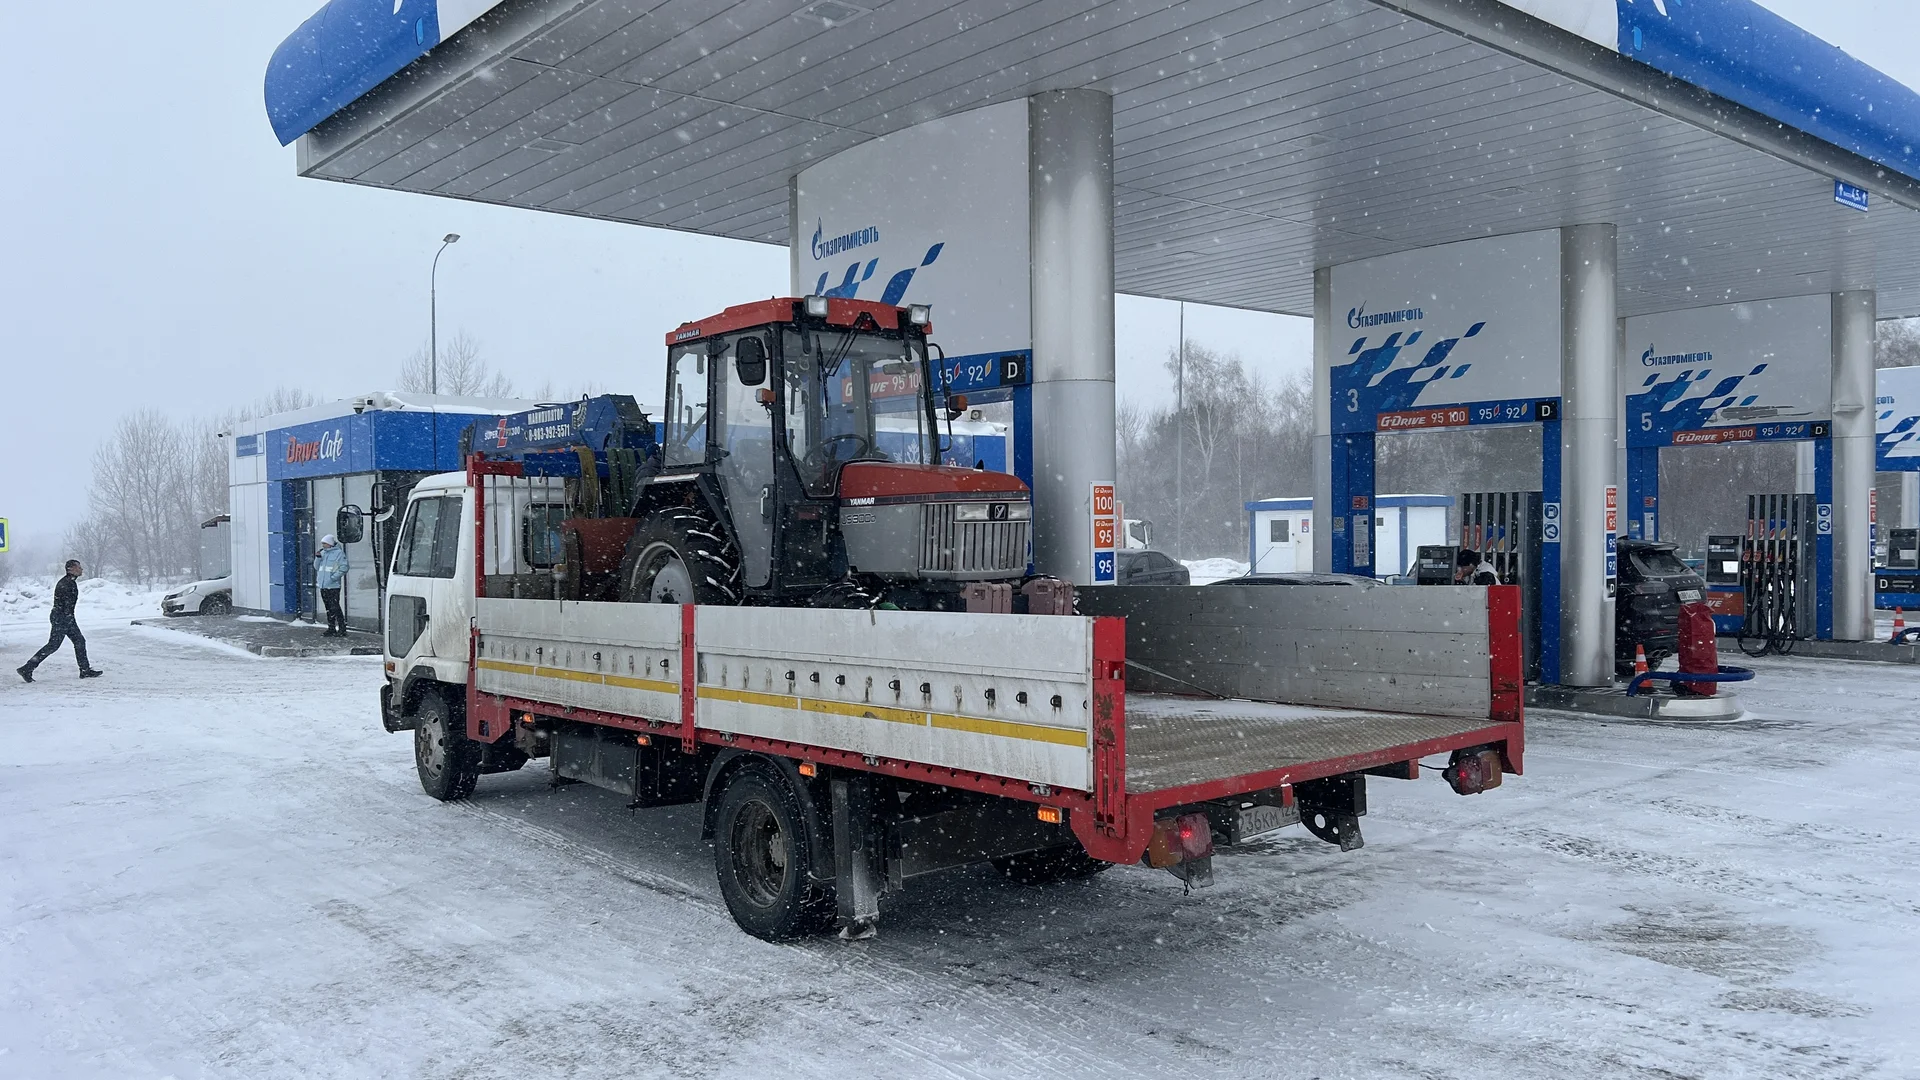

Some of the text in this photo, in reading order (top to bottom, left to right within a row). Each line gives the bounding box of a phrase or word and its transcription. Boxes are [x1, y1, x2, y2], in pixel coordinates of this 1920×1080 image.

[822, 225, 879, 258] ГАЗПРОМНЕФТЬ
[1361, 308, 1424, 327] ГАЗПРОМНЕФТЬ
[675, 329, 700, 341] YANMAR
[1655, 351, 1713, 366] ГАЗПРОМНЕФТЬ
[968, 365, 984, 383] 92
[1007, 362, 1018, 379] D
[1347, 388, 1359, 412] 3
[1431, 412, 1444, 424] 95
[1448, 410, 1466, 422] 100
[1479, 408, 1493, 420] 95
[1506, 407, 1520, 419] 92
[1541, 405, 1551, 417] D
[1641, 412, 1653, 431] 5
[1722, 430, 1735, 440] 95
[1738, 429, 1754, 438] 100
[1762, 427, 1774, 436] 95
[1785, 426, 1798, 436] 92
[1815, 426, 1823, 435] D
[286, 429, 343, 464] DRIVE Cafe
[849, 497, 875, 505] YANMAR
[1095, 496, 1113, 510] 100
[1098, 529, 1112, 543] 95
[1098, 559, 1112, 574] 95
[1880, 579, 1888, 589] D
